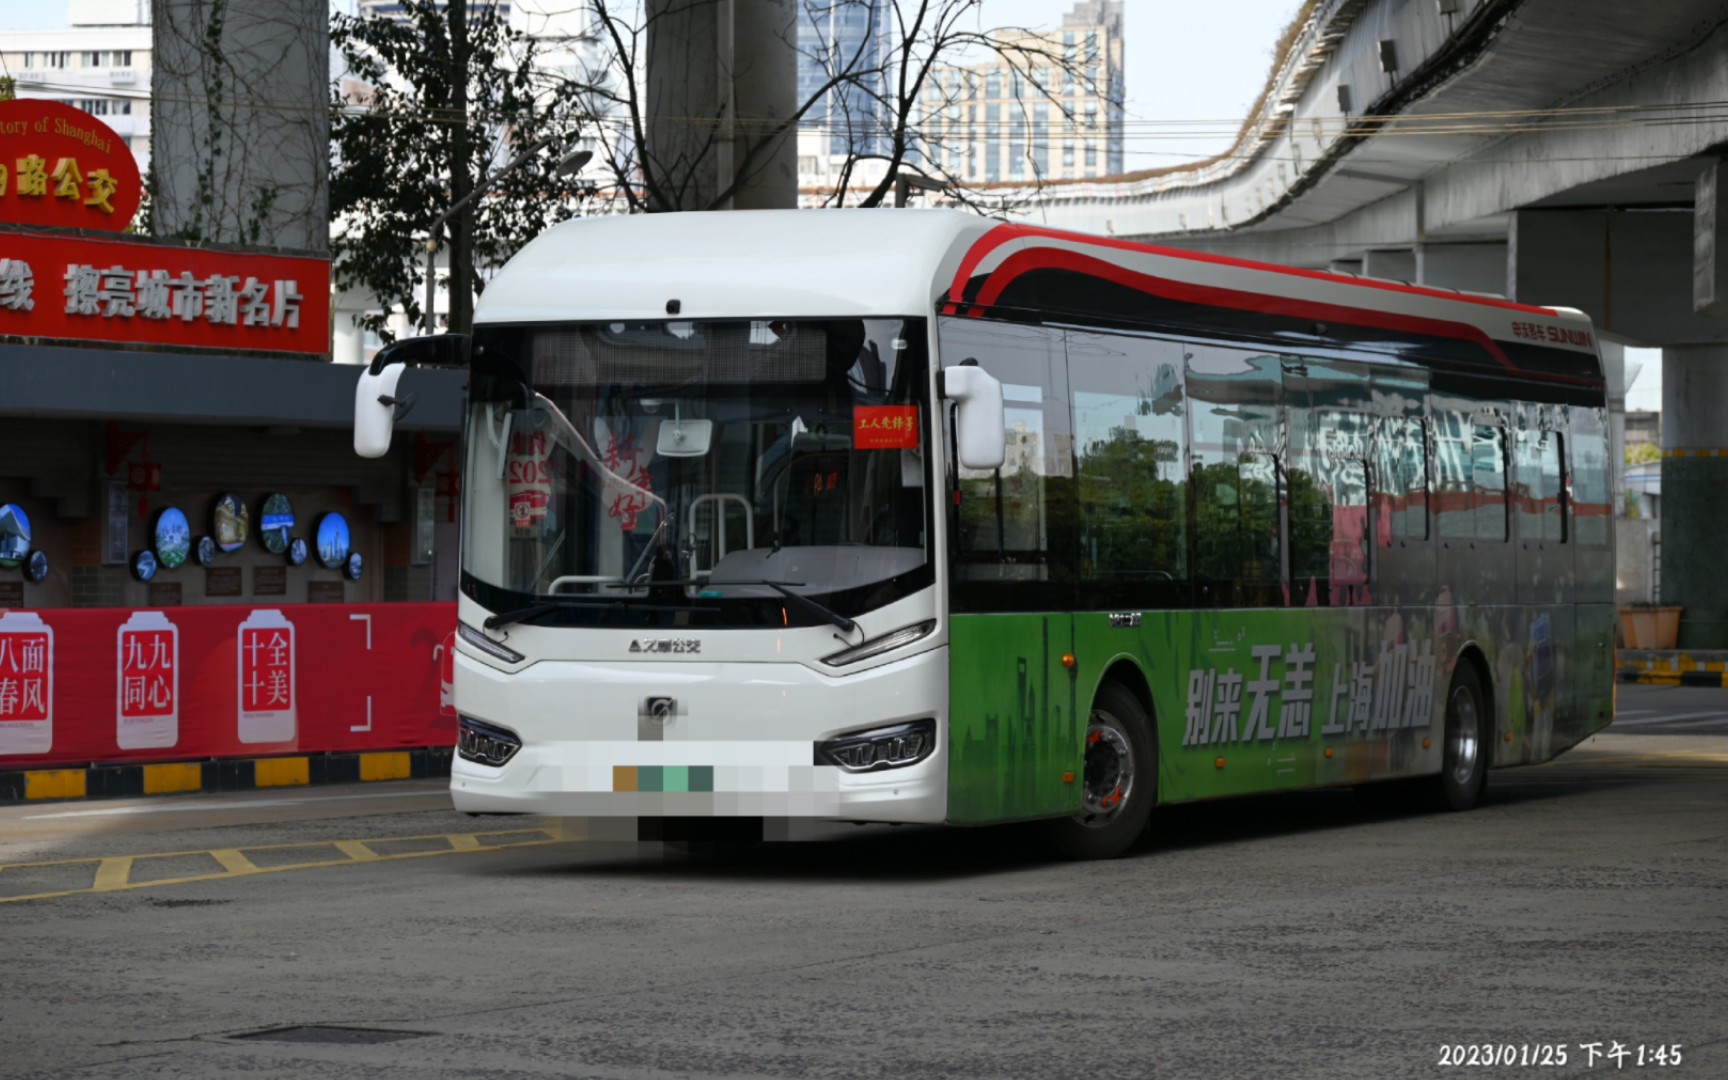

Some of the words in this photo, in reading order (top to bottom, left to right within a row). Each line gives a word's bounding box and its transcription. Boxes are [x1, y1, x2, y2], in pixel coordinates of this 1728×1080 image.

[35, 116, 49, 132] of
[55, 117, 112, 155] Shanghai
[64, 264, 303, 329] 擦亮城市新名片
[123, 634, 171, 671] 九九
[243, 632, 288, 667] 十全
[123, 675, 171, 711] 同心
[243, 670, 288, 706] 十美
[1182, 642, 1316, 746] 别来无恙
[1321, 638, 1436, 734] 上海加油
